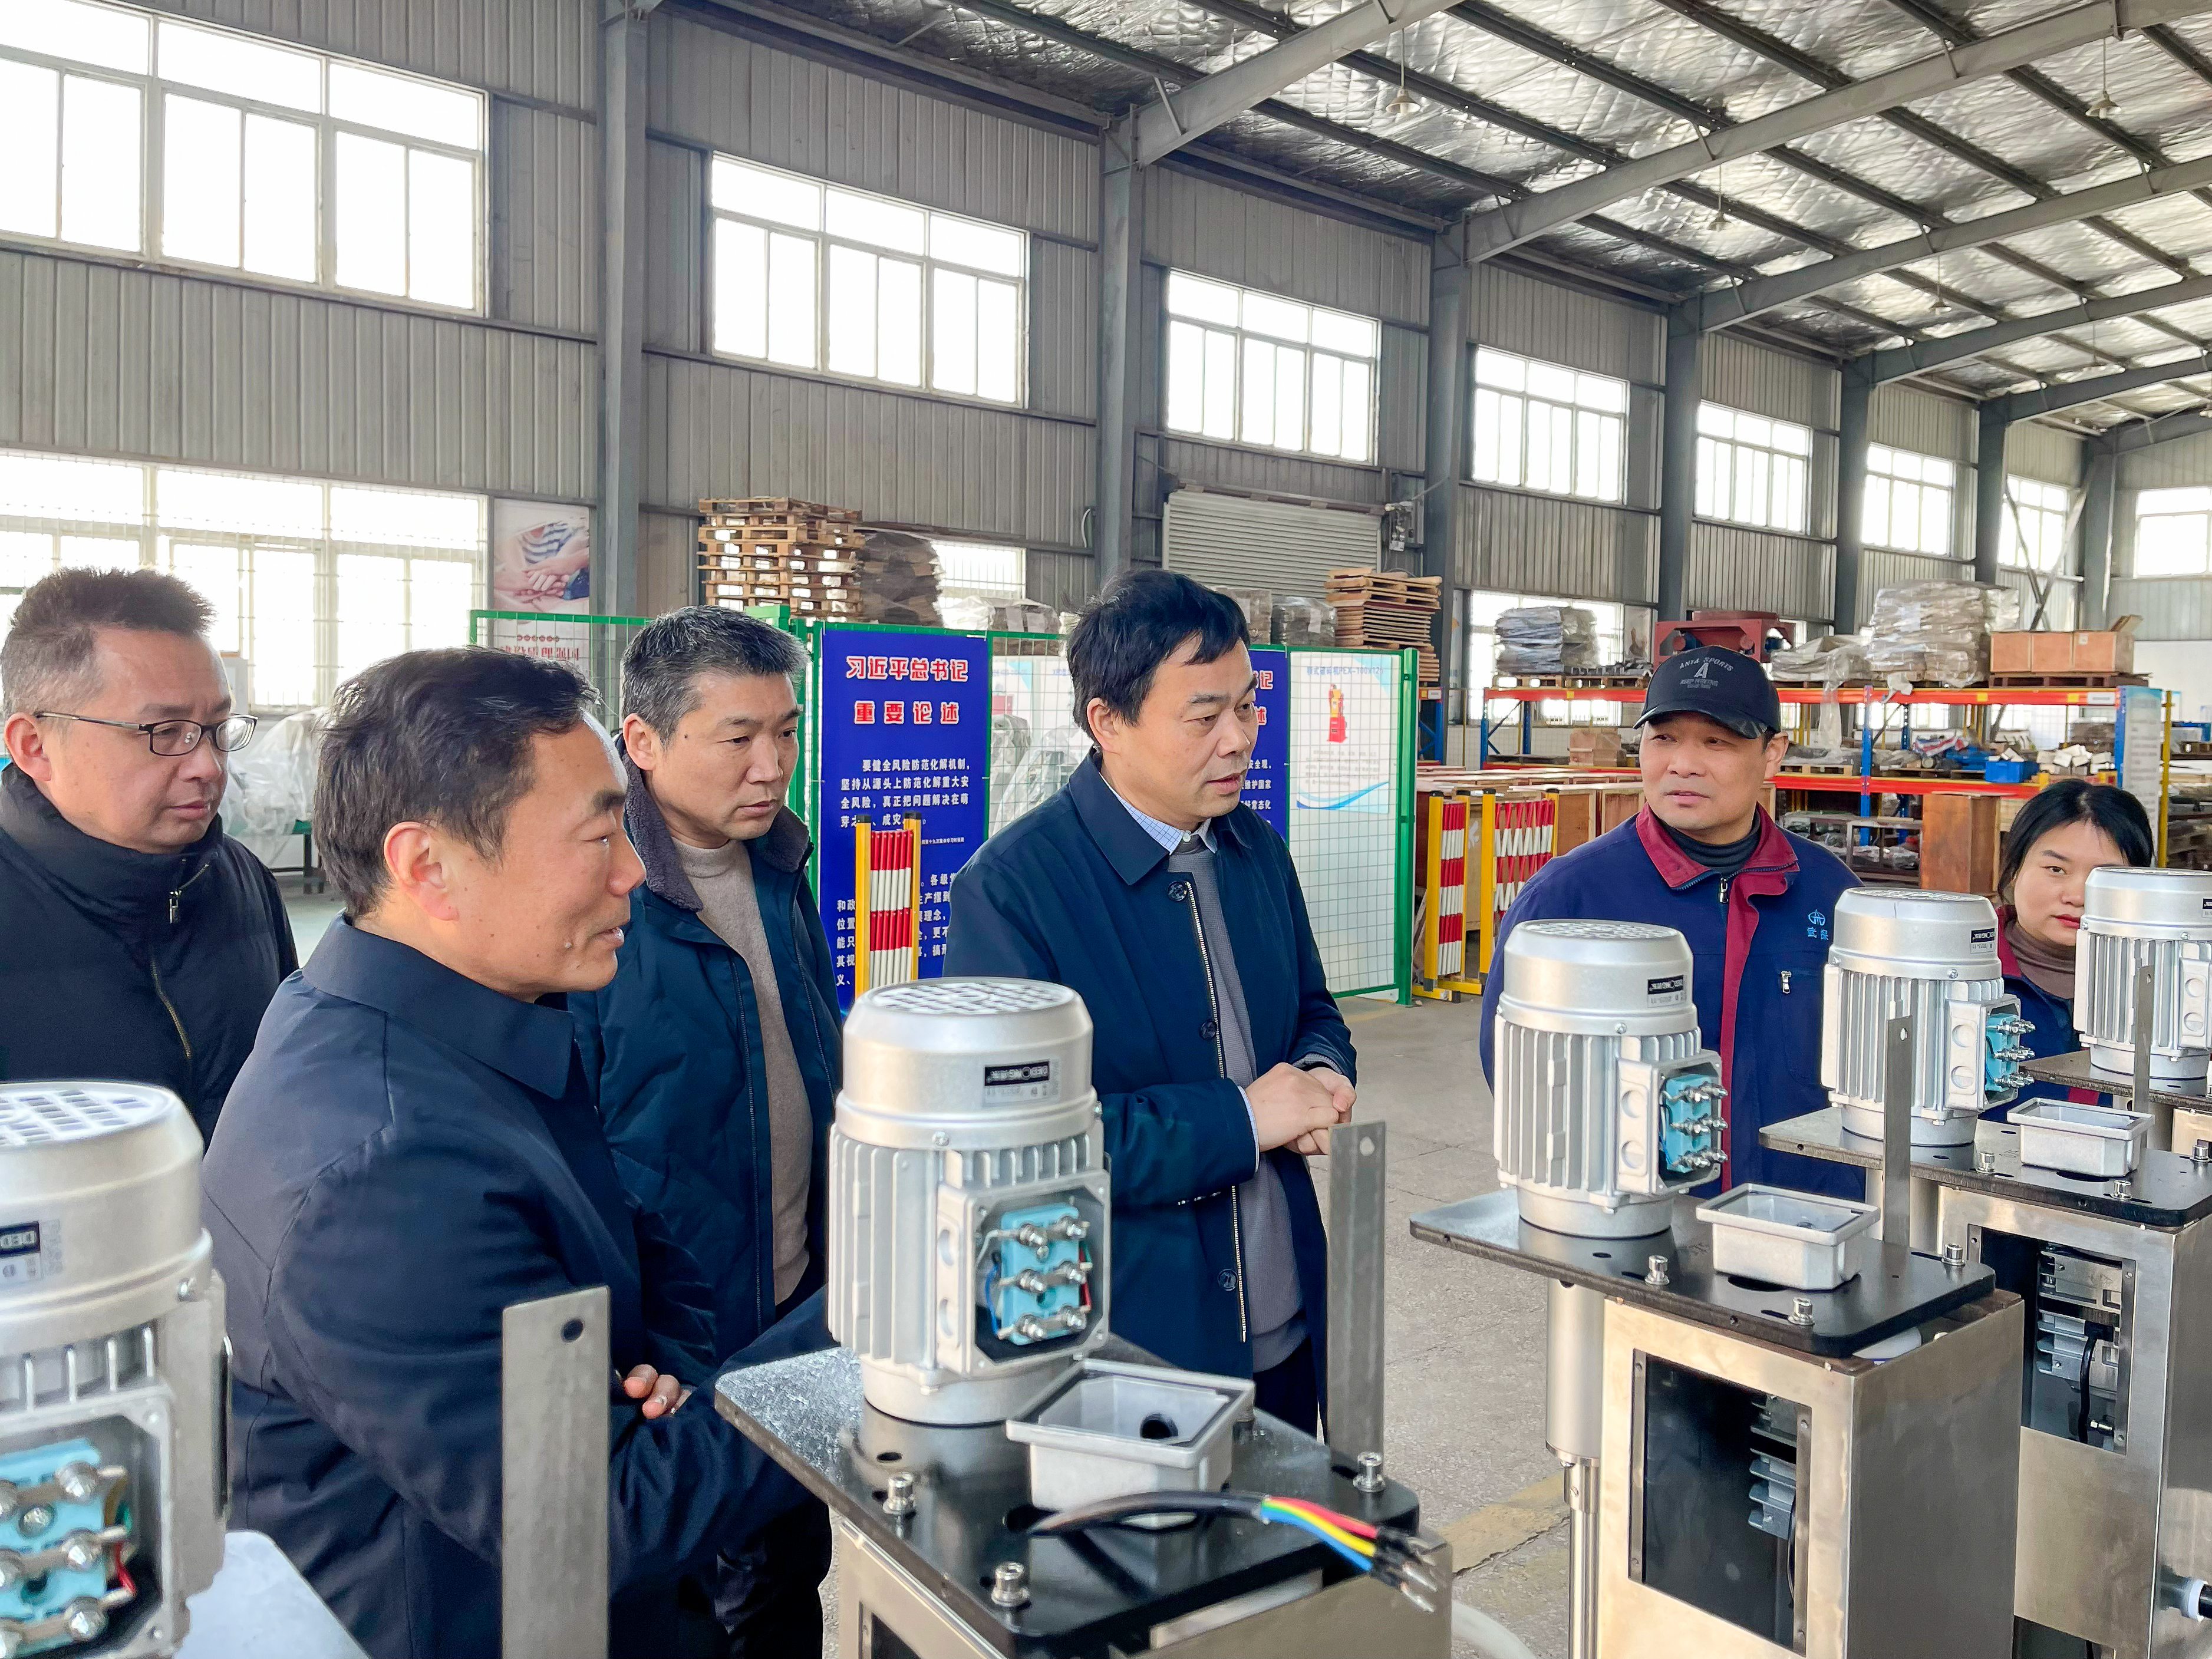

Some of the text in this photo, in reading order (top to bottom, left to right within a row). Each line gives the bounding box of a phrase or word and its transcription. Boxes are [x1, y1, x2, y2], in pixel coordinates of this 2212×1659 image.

[846, 655, 968, 682] 习近平总书记
[1693, 662, 1709, 678] A
[1703, 657, 1735, 672] SPORTS
[854, 700, 960, 725] 重要论述
[840, 776, 970, 791] 坚持从源头上防范化解重大安
[1241, 779, 1272, 790] 维护国家
[836, 917, 855, 931] 位置
[836, 935, 855, 950] 能只
